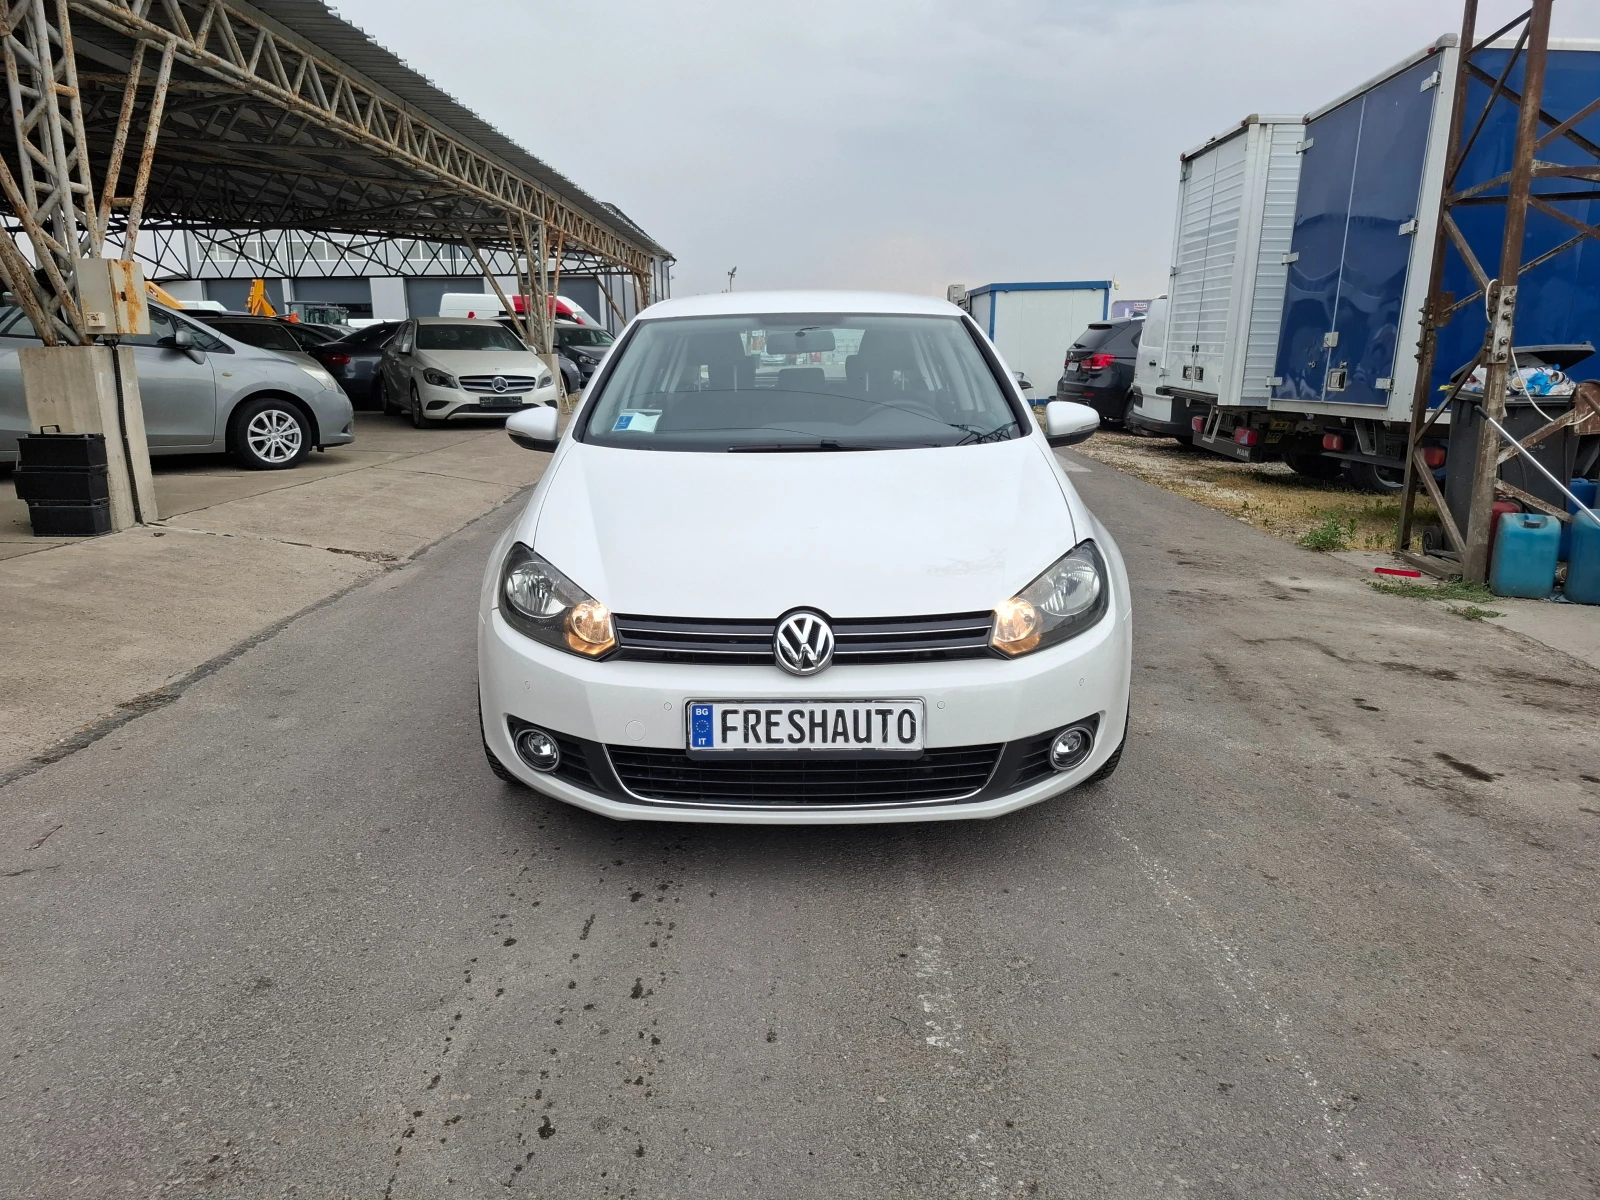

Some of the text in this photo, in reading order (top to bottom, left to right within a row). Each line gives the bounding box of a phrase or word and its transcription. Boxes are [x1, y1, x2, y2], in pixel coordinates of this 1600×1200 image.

[1236, 447, 1249, 457] MAN
[695, 708, 709, 716] BG
[720, 708, 917, 744] FRESHAUTO
[698, 737, 707, 745] IT
